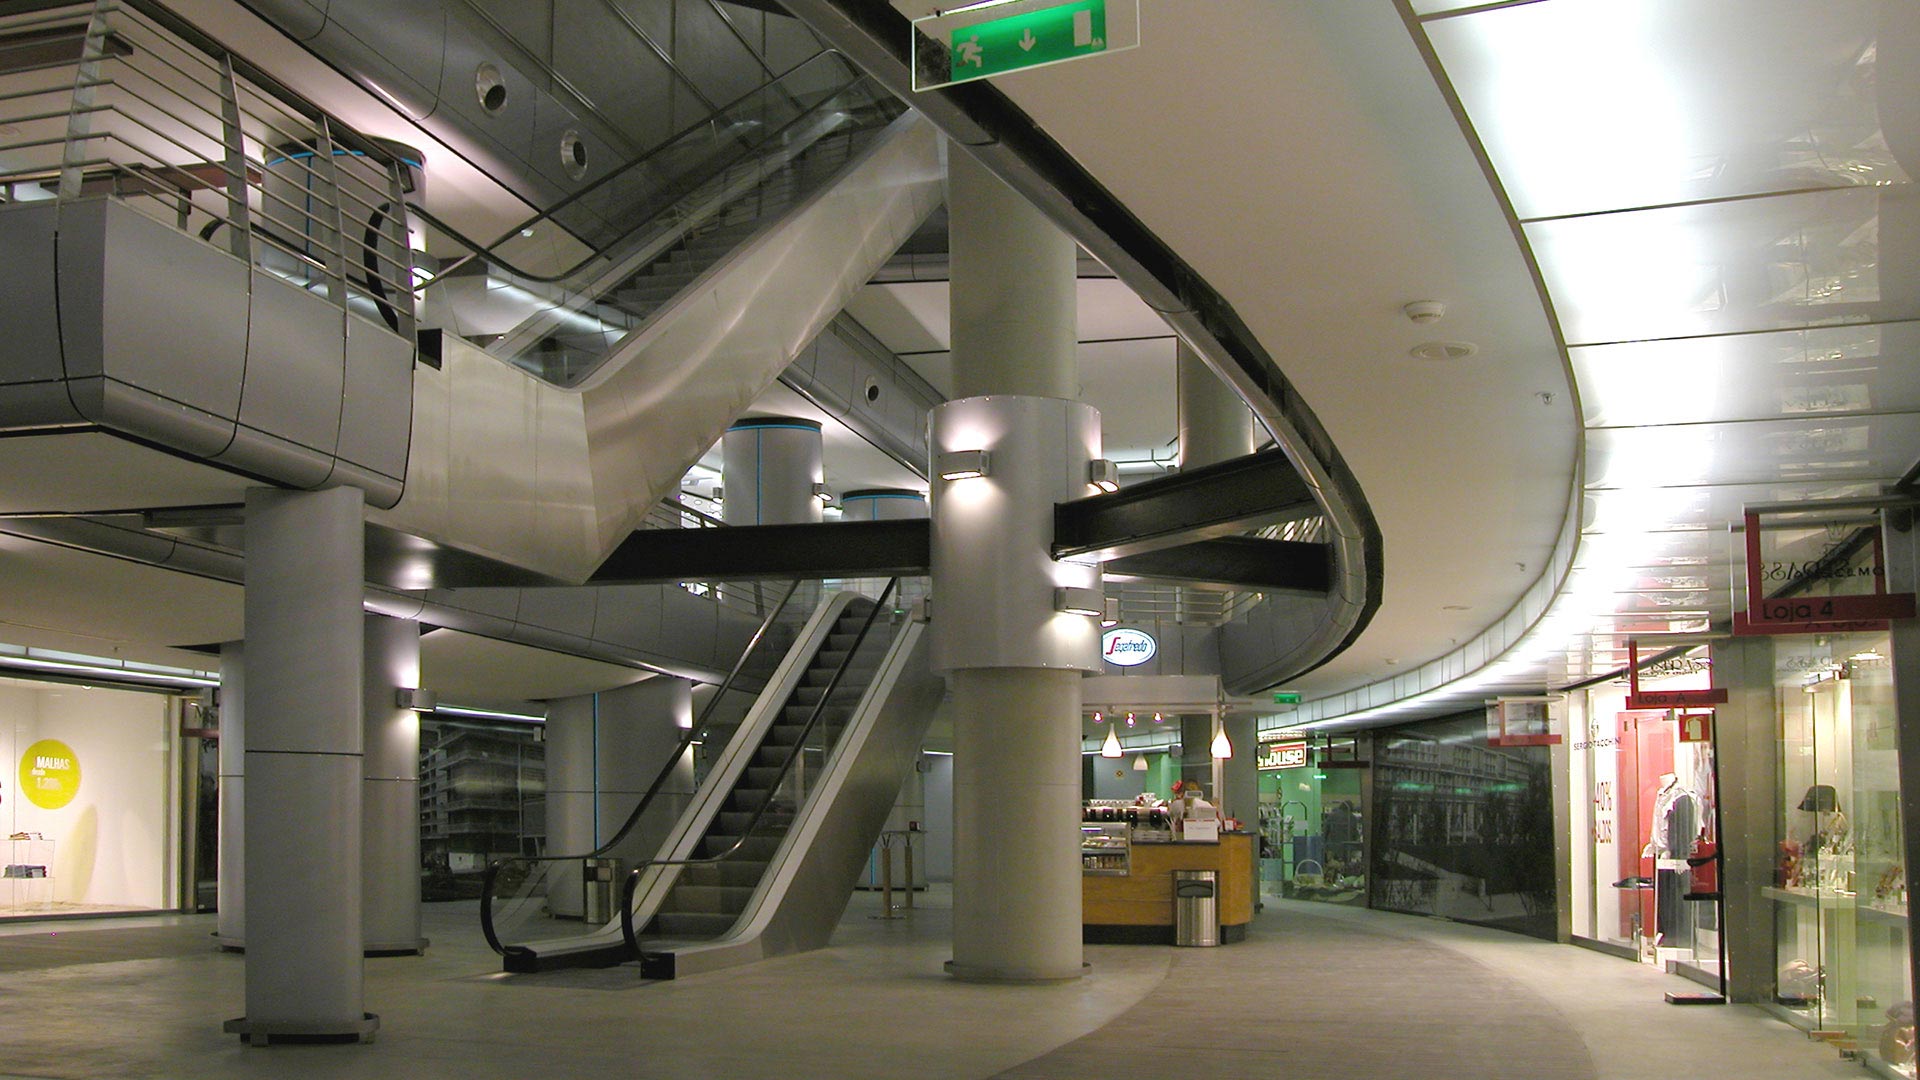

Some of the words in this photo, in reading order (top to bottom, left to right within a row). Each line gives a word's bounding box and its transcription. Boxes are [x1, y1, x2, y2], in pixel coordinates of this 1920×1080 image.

[1762, 602, 1811, 622] Loja
[1820, 601, 1834, 615] 4
[36, 755, 70, 770] MALHAS
